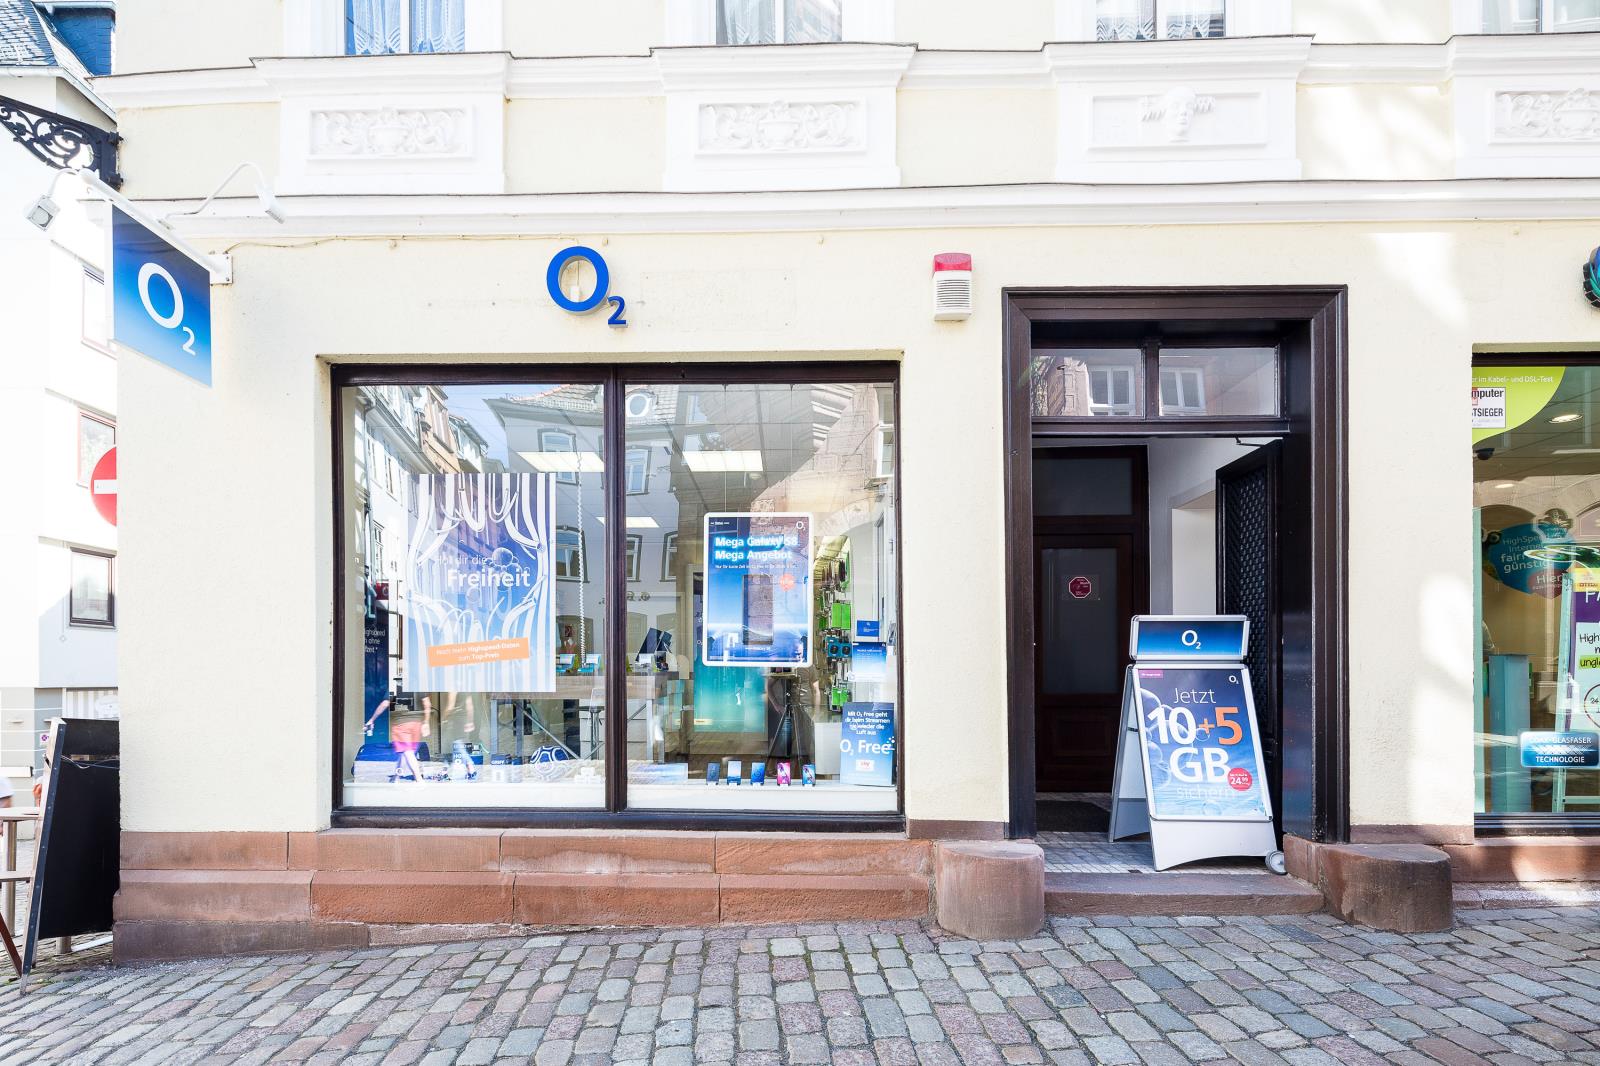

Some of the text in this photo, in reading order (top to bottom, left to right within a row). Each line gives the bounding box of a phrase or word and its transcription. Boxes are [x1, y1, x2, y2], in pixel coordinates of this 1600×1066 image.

[715, 536, 745, 548] Mega
[715, 550, 793, 562] Mega Angebot
[447, 566, 531, 587] Freiheit
[1579, 633, 1600, 648] High
[1174, 688, 1216, 703] Jetzt
[1148, 706, 1243, 745] 10+5
[858, 739, 891, 755] Free
[1170, 747, 1230, 783] GB
